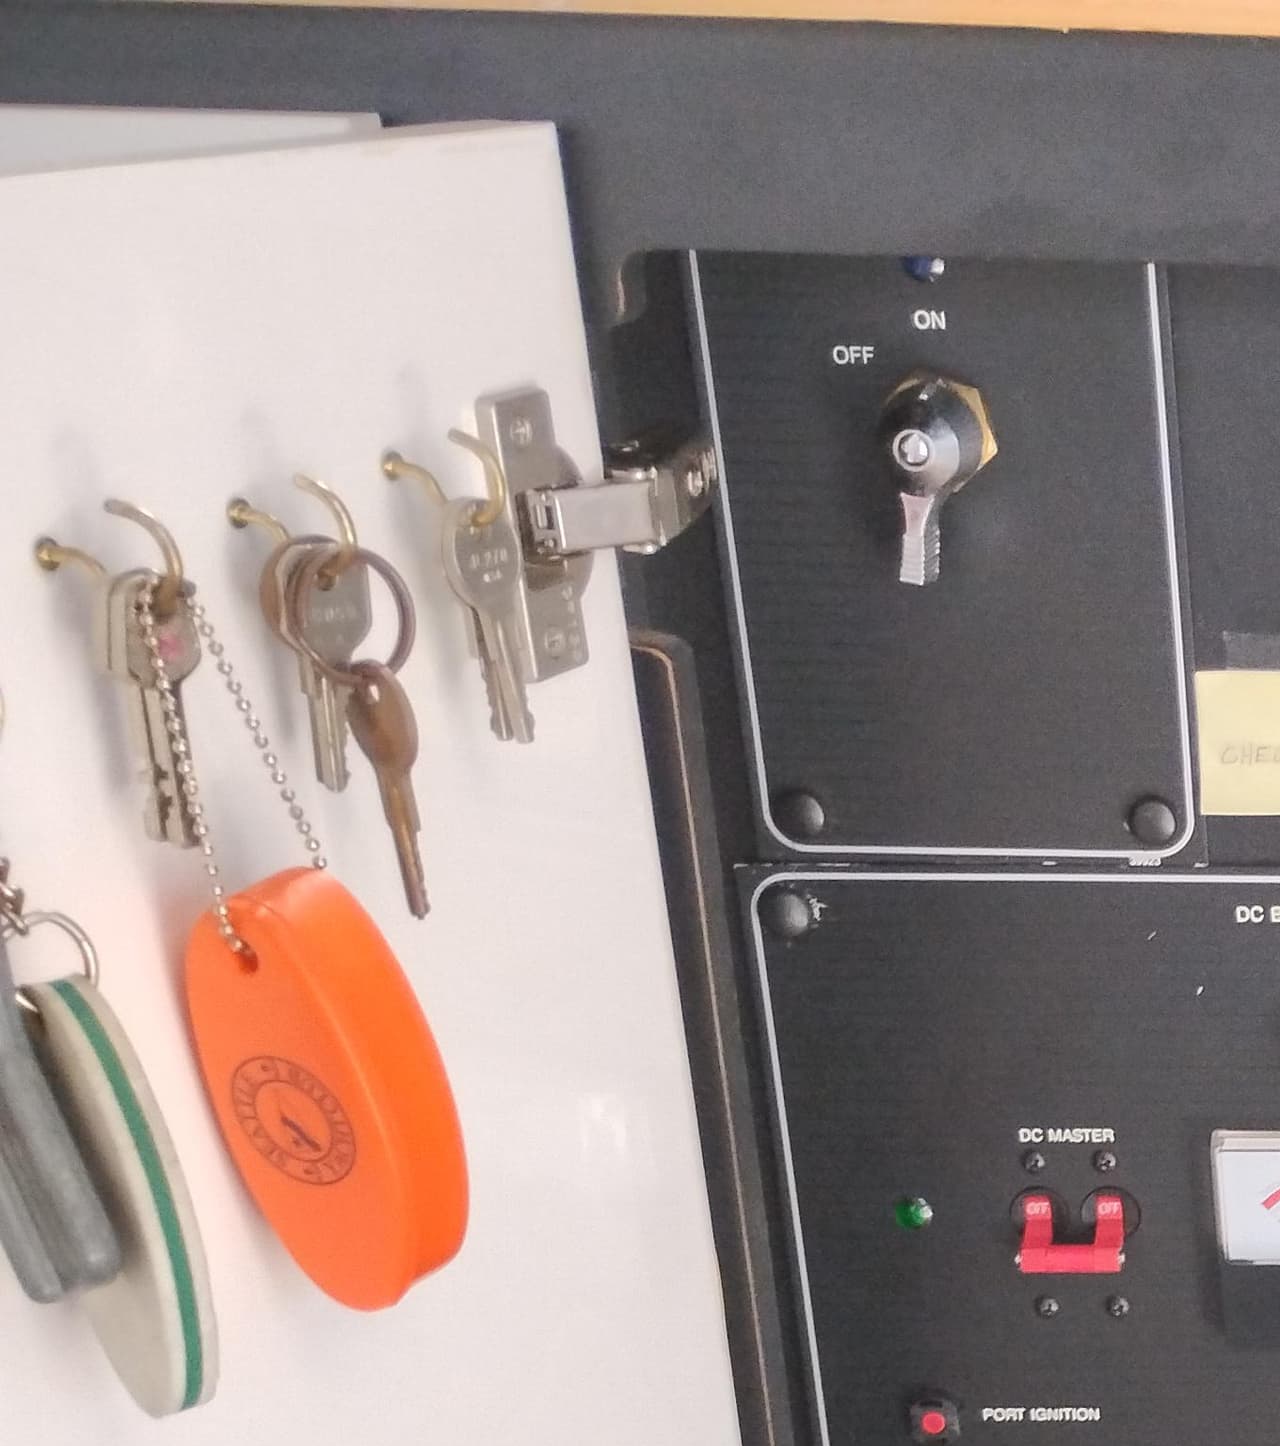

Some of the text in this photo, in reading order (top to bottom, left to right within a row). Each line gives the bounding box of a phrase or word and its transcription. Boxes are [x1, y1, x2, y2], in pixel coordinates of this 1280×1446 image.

[914, 310, 945, 329] ON
[833, 346, 874, 364] OFF
[1236, 906, 1264, 923] DC
[1019, 1128, 1114, 1142] DC MASTER
[982, 1408, 1100, 1421] PORT IGNITION
